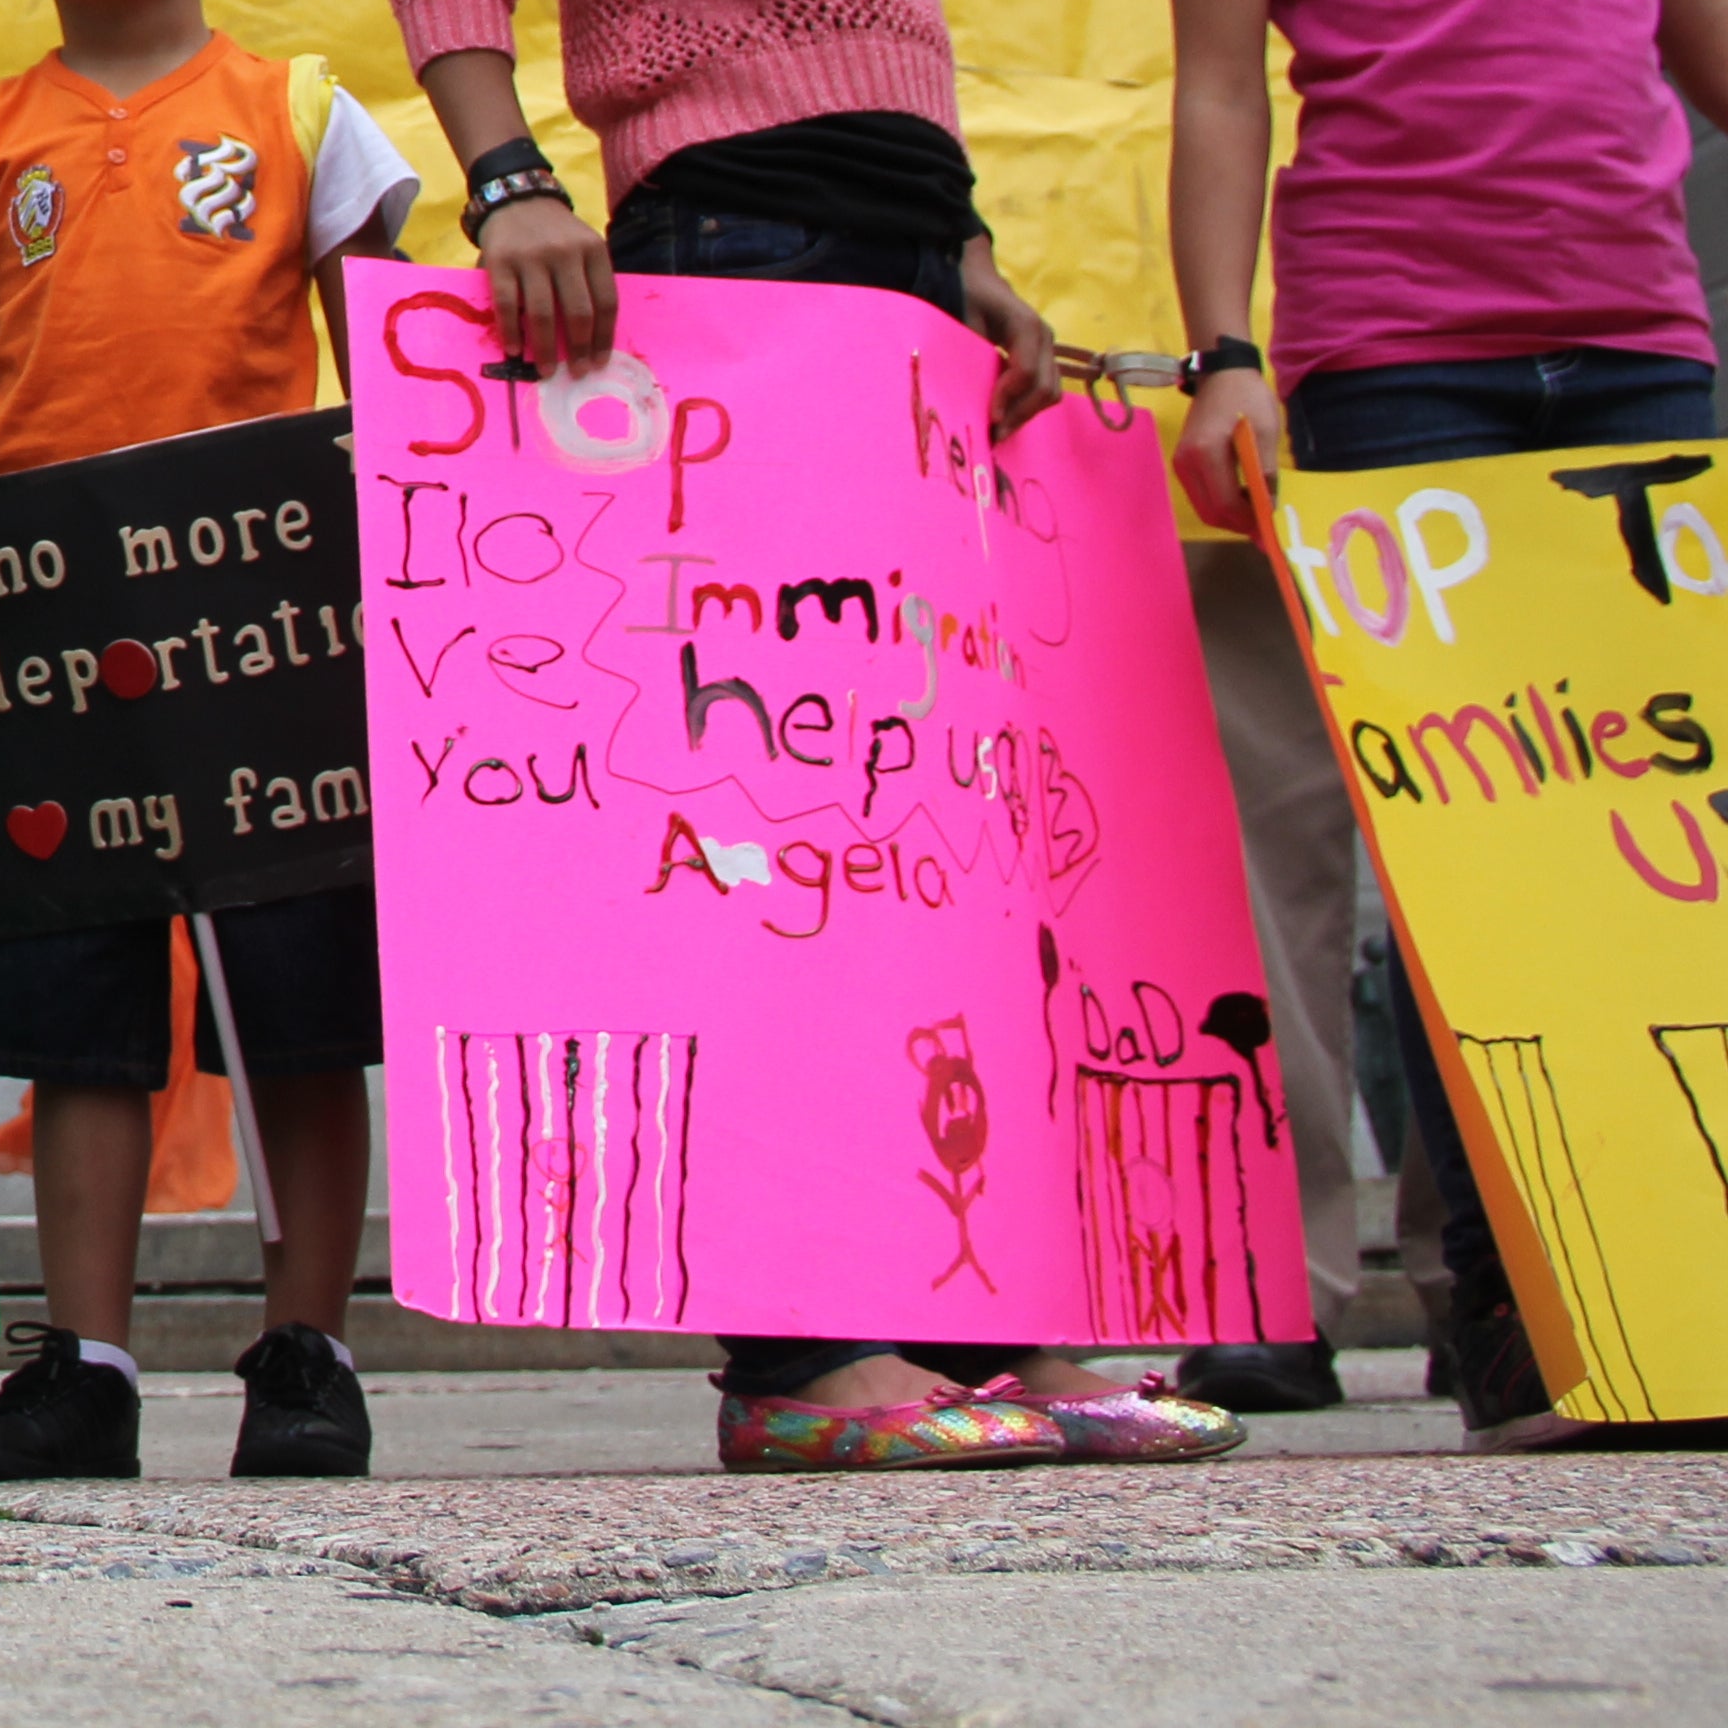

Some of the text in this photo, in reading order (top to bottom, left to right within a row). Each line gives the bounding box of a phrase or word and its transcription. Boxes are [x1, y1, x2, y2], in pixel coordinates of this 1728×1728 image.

[118, 499, 314, 577] more
[680, 640, 916, 818] help
[1350, 676, 1713, 804] amilies
[88, 793, 185, 861] my
[224, 765, 371, 836] fam
